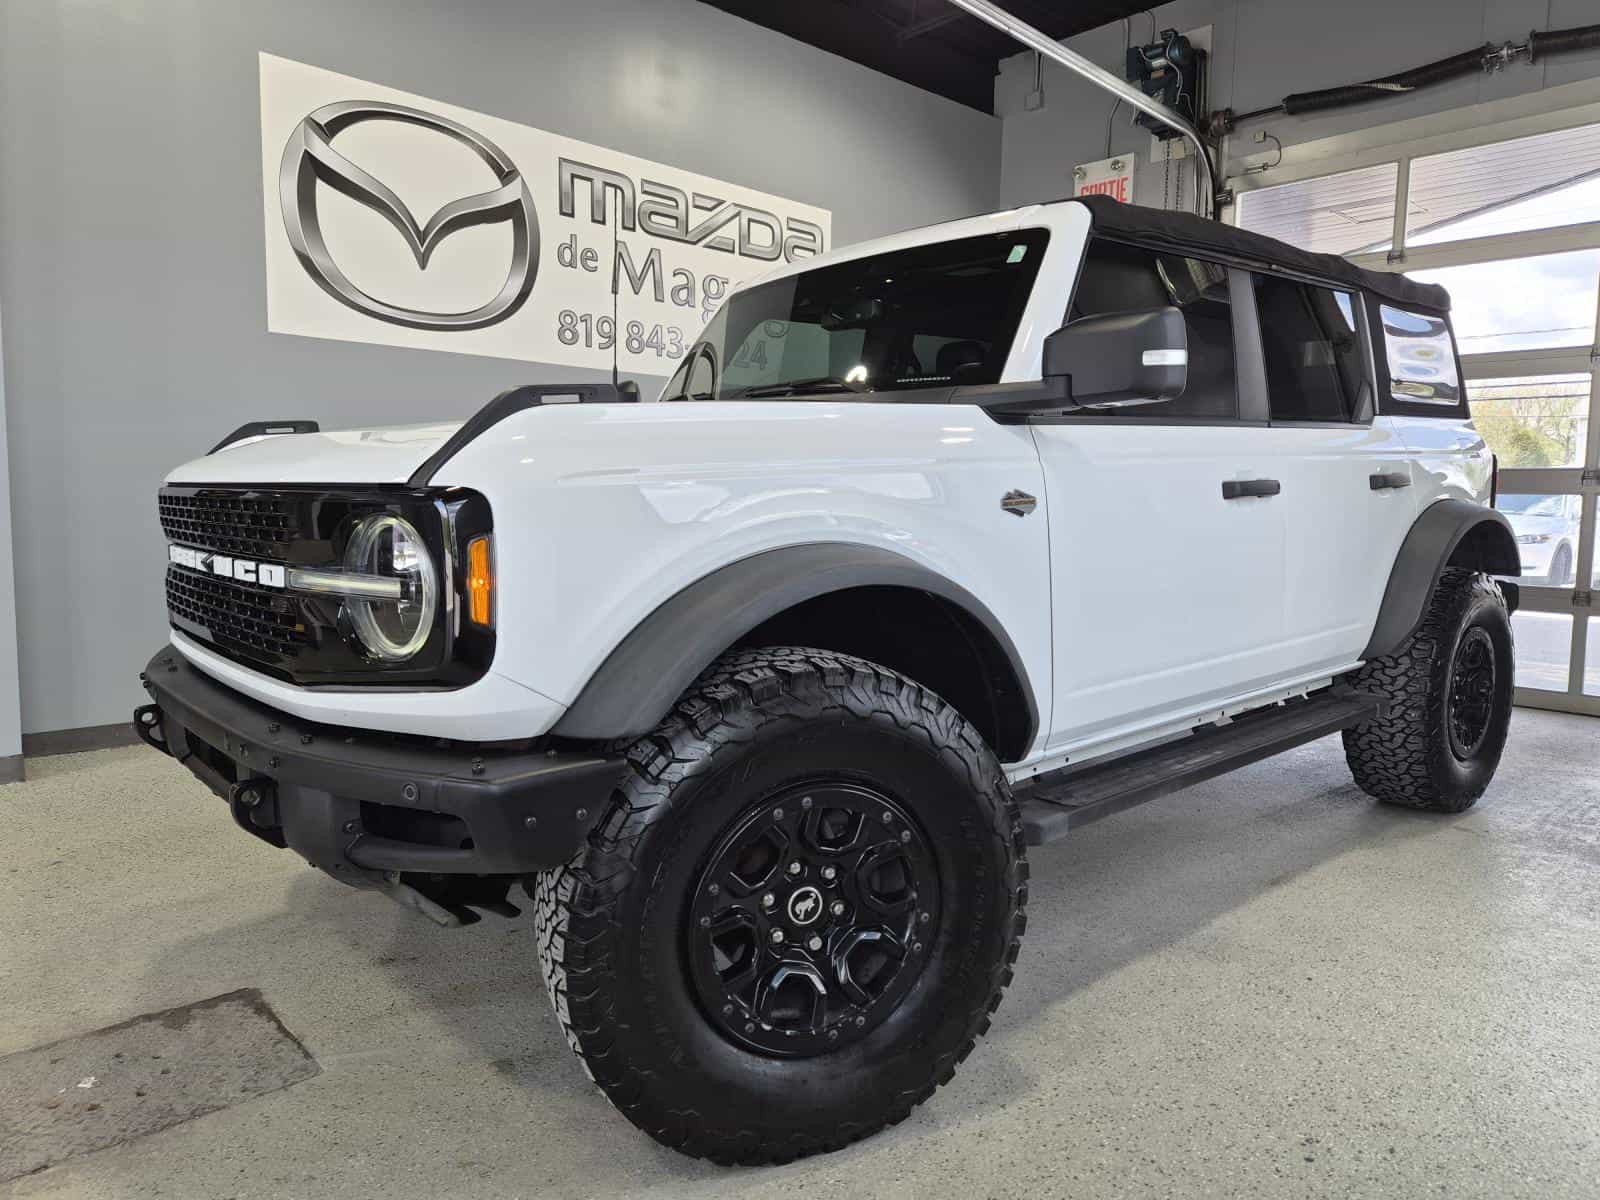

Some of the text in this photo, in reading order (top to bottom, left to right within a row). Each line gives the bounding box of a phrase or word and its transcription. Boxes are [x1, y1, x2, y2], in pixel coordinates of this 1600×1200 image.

[557, 233, 745, 325] de Mag
[557, 308, 617, 350] 819
